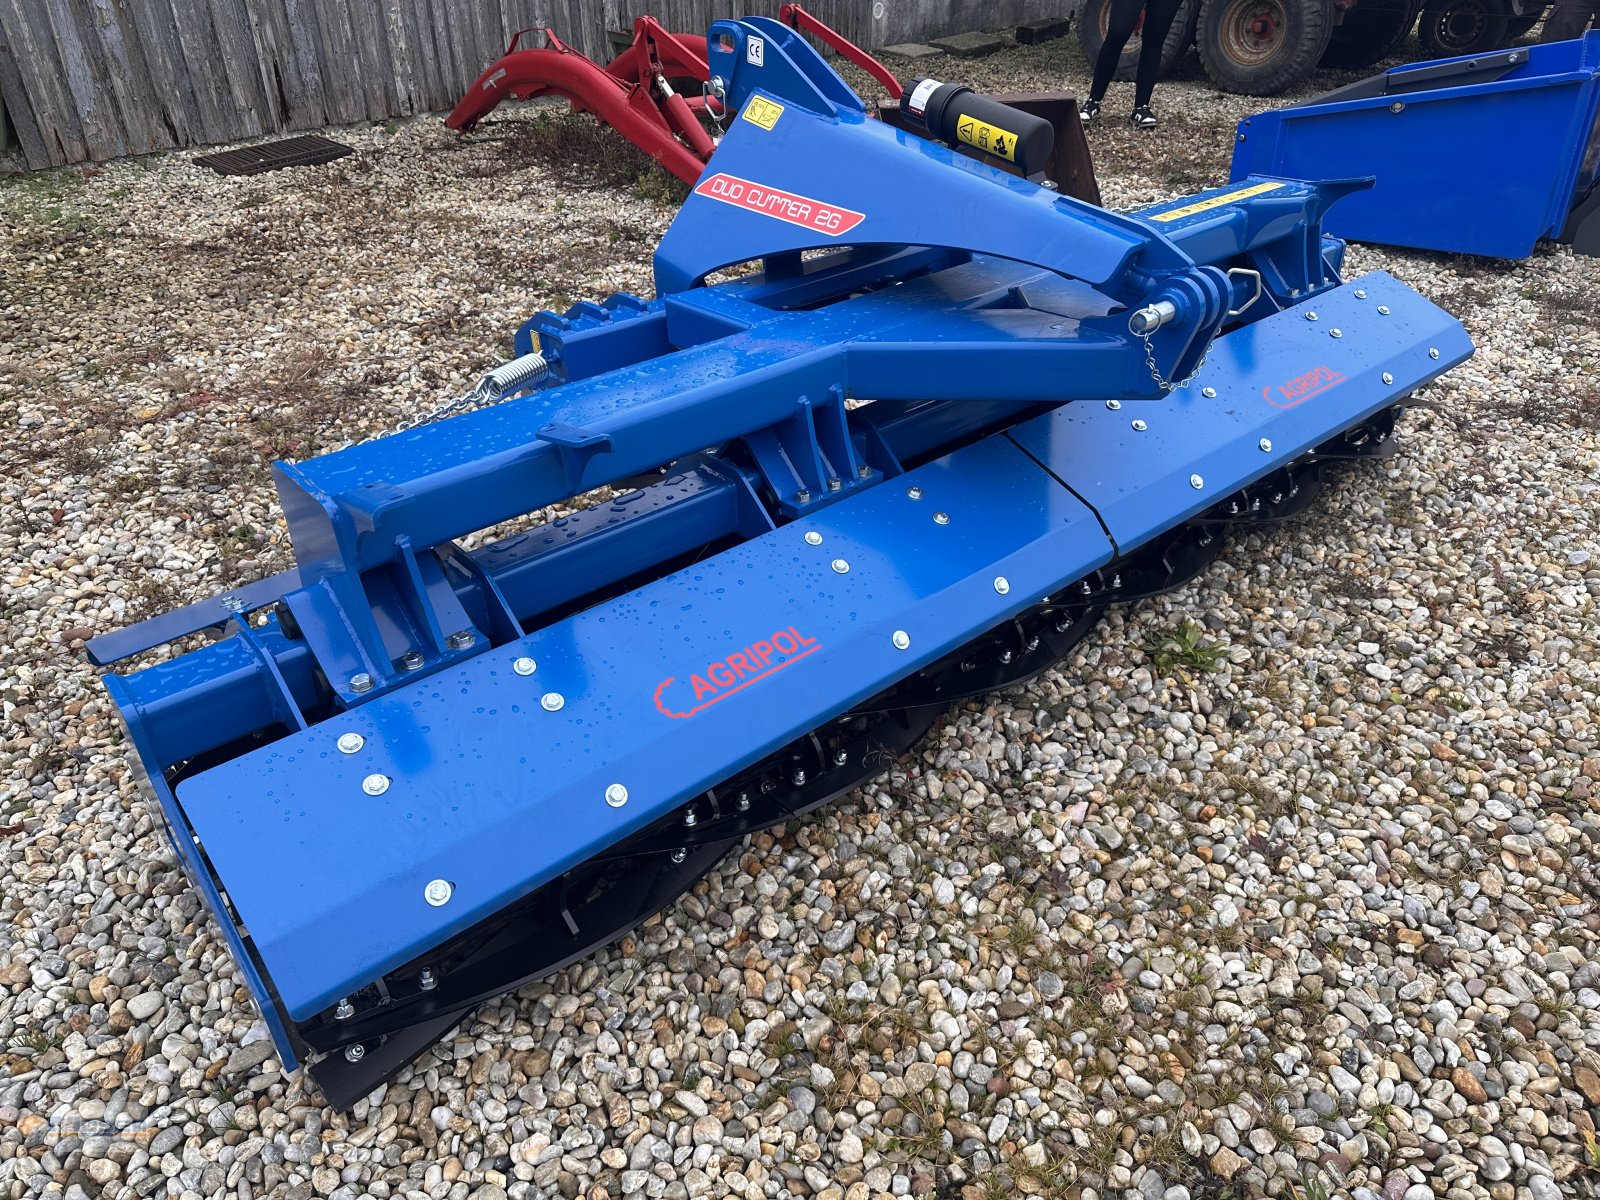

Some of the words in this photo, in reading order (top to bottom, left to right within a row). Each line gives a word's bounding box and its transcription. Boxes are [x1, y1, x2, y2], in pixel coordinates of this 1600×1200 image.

[749, 43, 760, 58] CE
[711, 178, 744, 199] DUO
[746, 189, 812, 220] CUTTER
[814, 209, 842, 230] 2G
[1278, 364, 1342, 400] AGRIPOL
[690, 626, 817, 700] AGRIPOL
